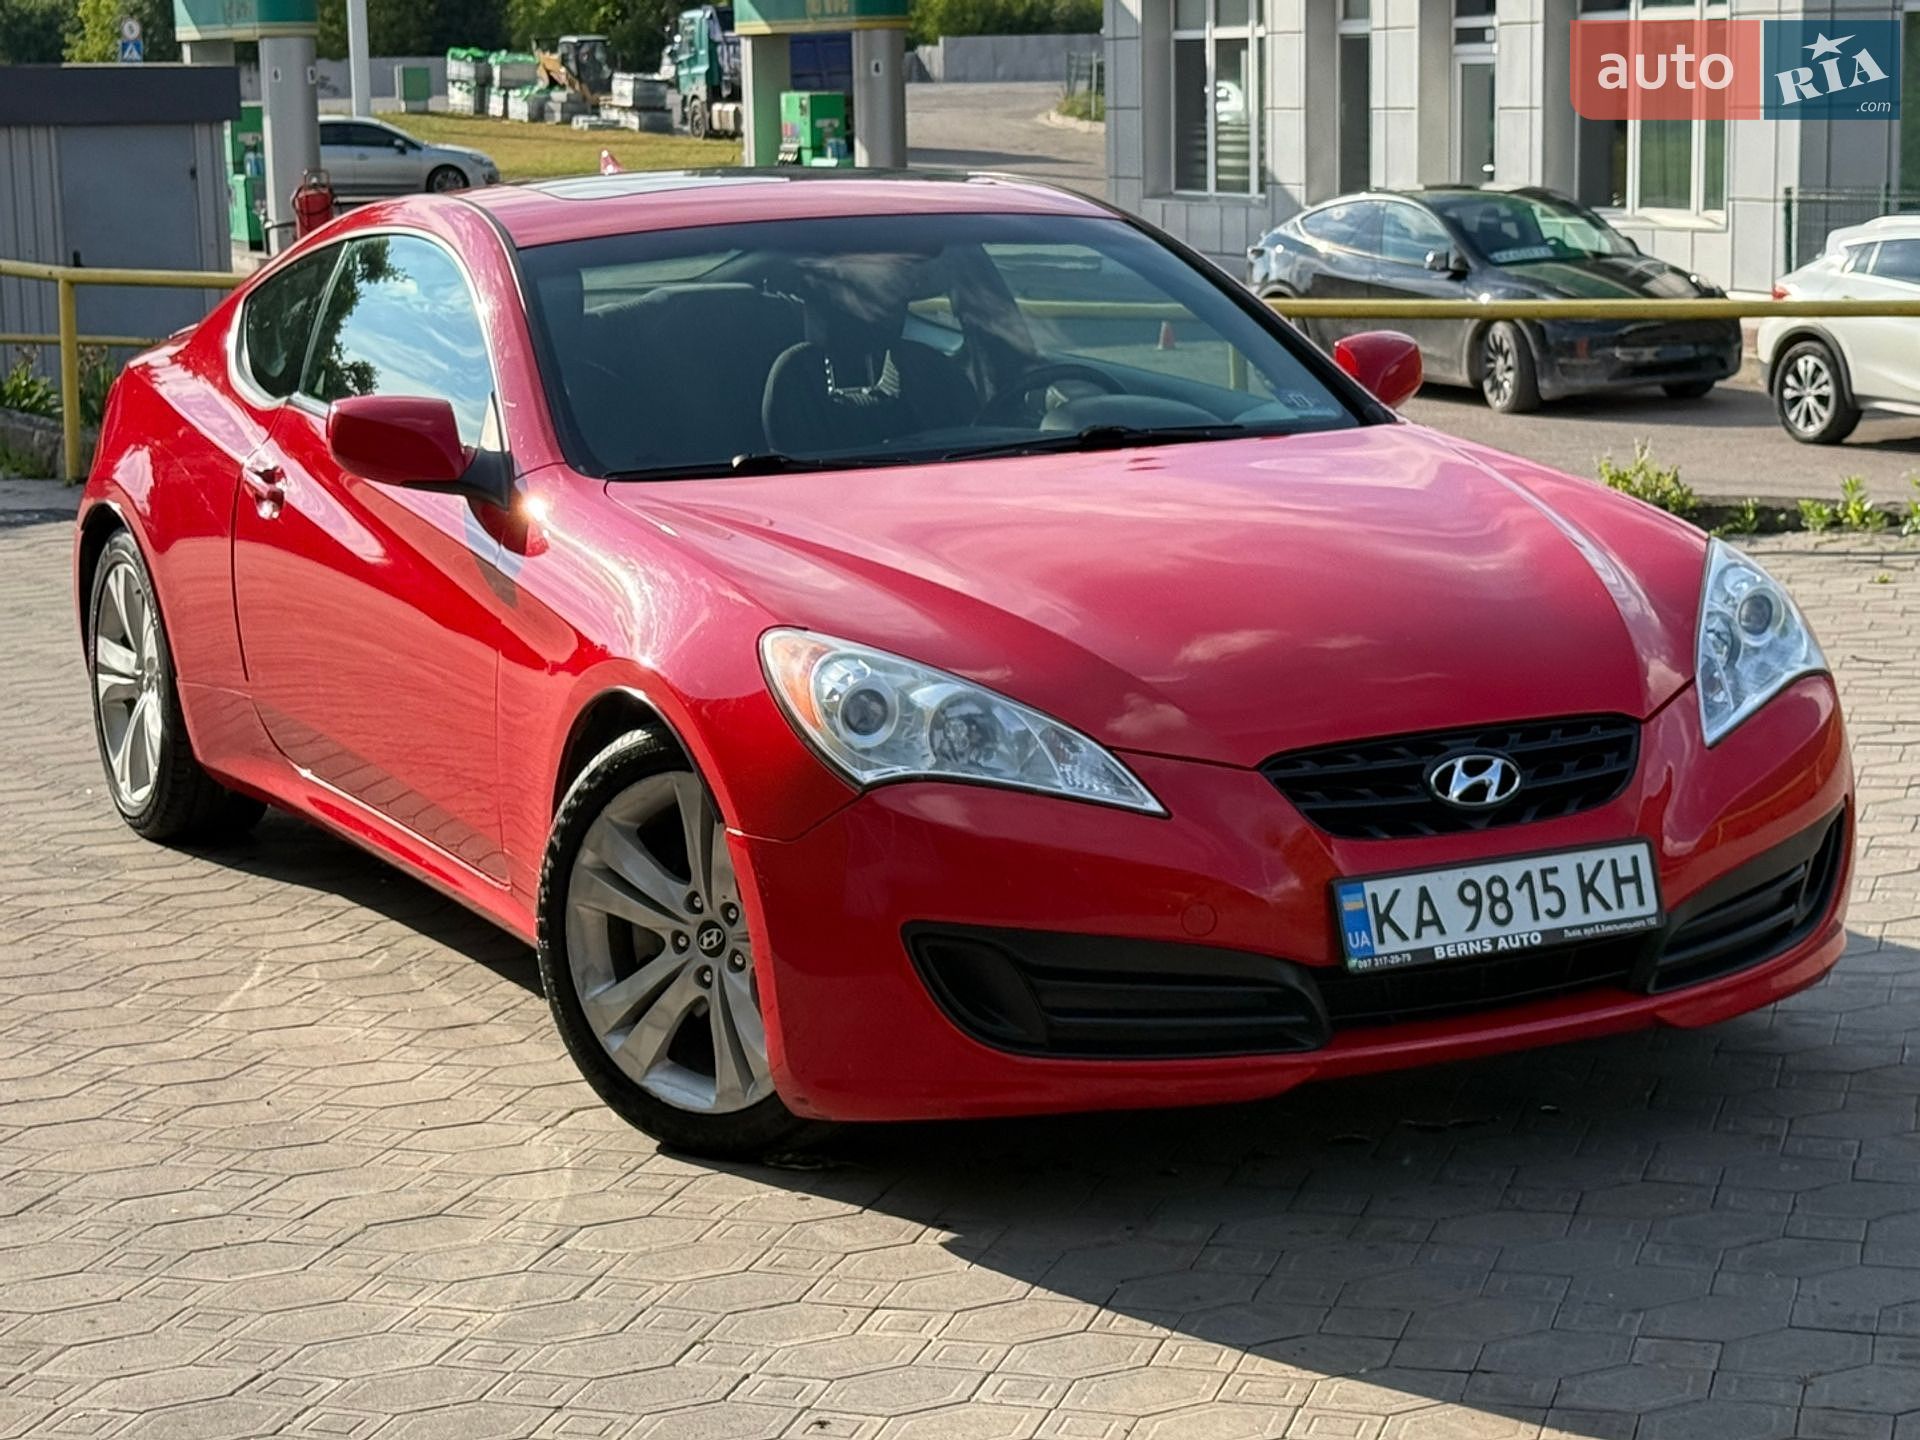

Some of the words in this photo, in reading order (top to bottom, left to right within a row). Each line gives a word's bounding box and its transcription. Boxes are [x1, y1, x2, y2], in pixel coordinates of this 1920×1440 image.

[1371, 885, 1446, 945] KA
[1457, 866, 1566, 932] 9815
[1576, 855, 1646, 914] KH
[1347, 930, 1372, 949] UA
[1433, 939, 1493, 960] BERNS
[1497, 931, 1542, 951] AUTO
